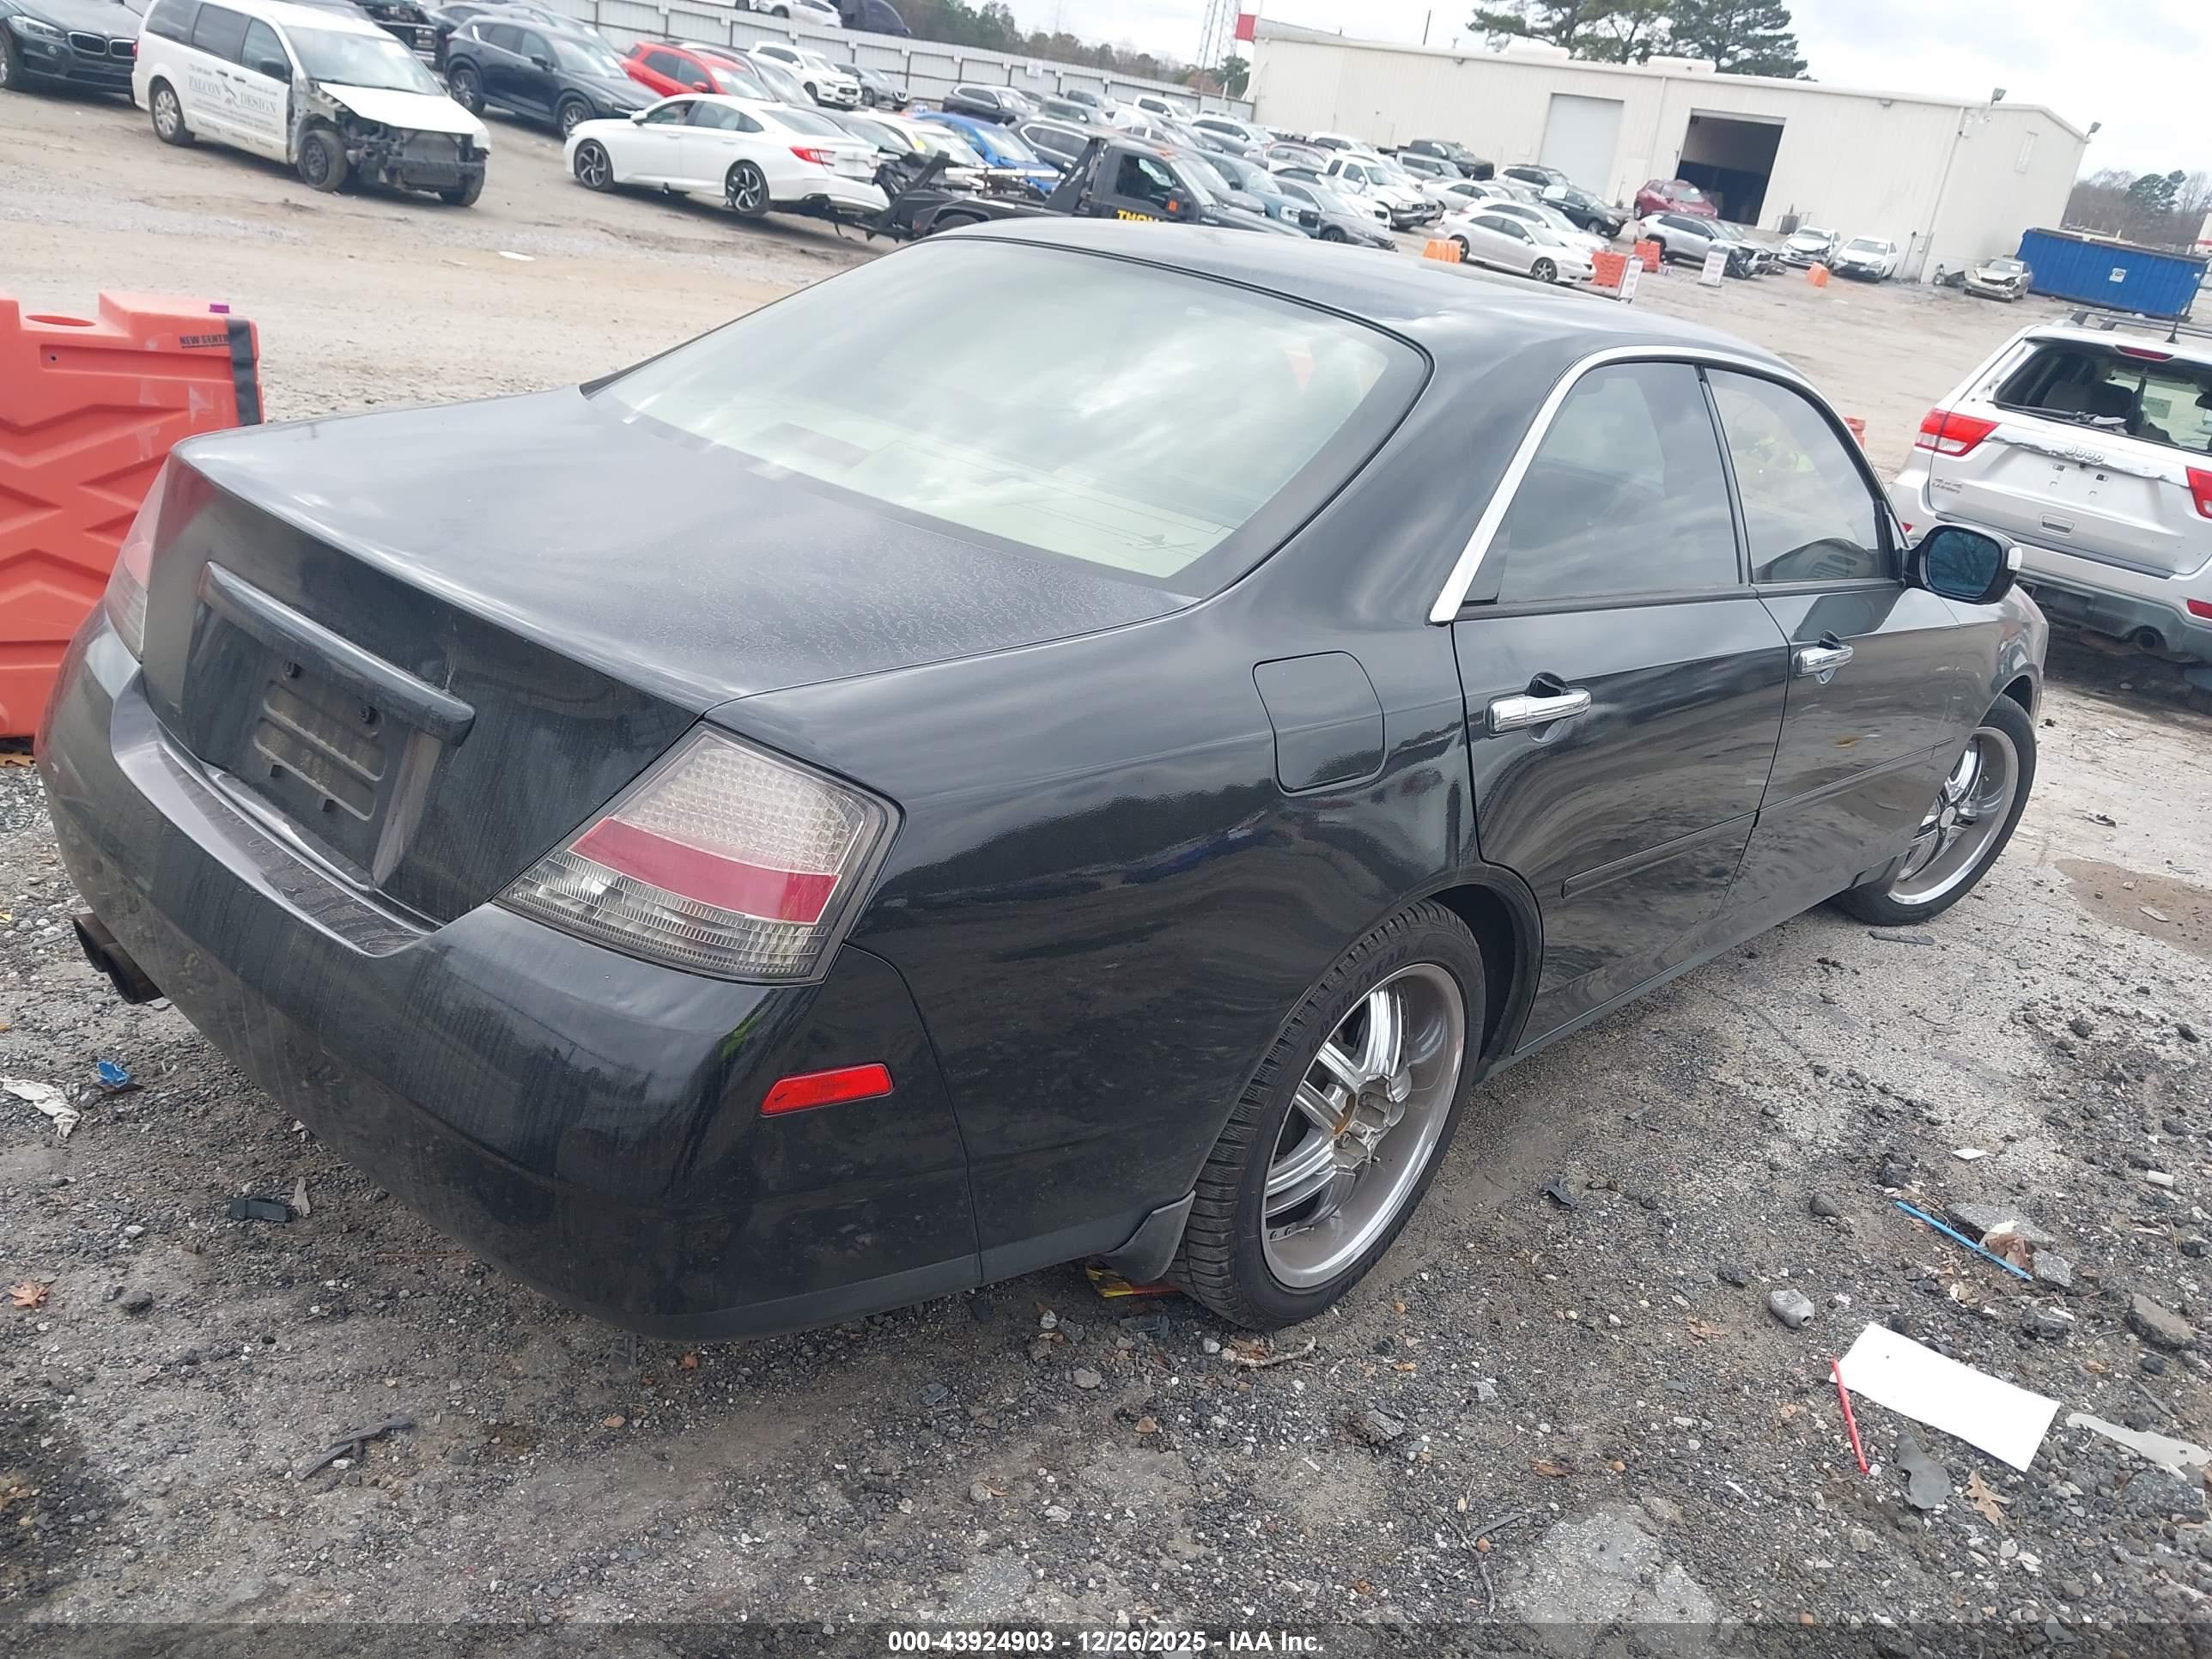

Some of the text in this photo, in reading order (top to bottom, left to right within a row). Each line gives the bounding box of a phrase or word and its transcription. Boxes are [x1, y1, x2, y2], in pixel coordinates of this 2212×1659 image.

[188, 75, 276, 112] FALCON DESIGN
[179, 336, 199, 344] NEW
[2064, 444, 2105, 464] Jeep
